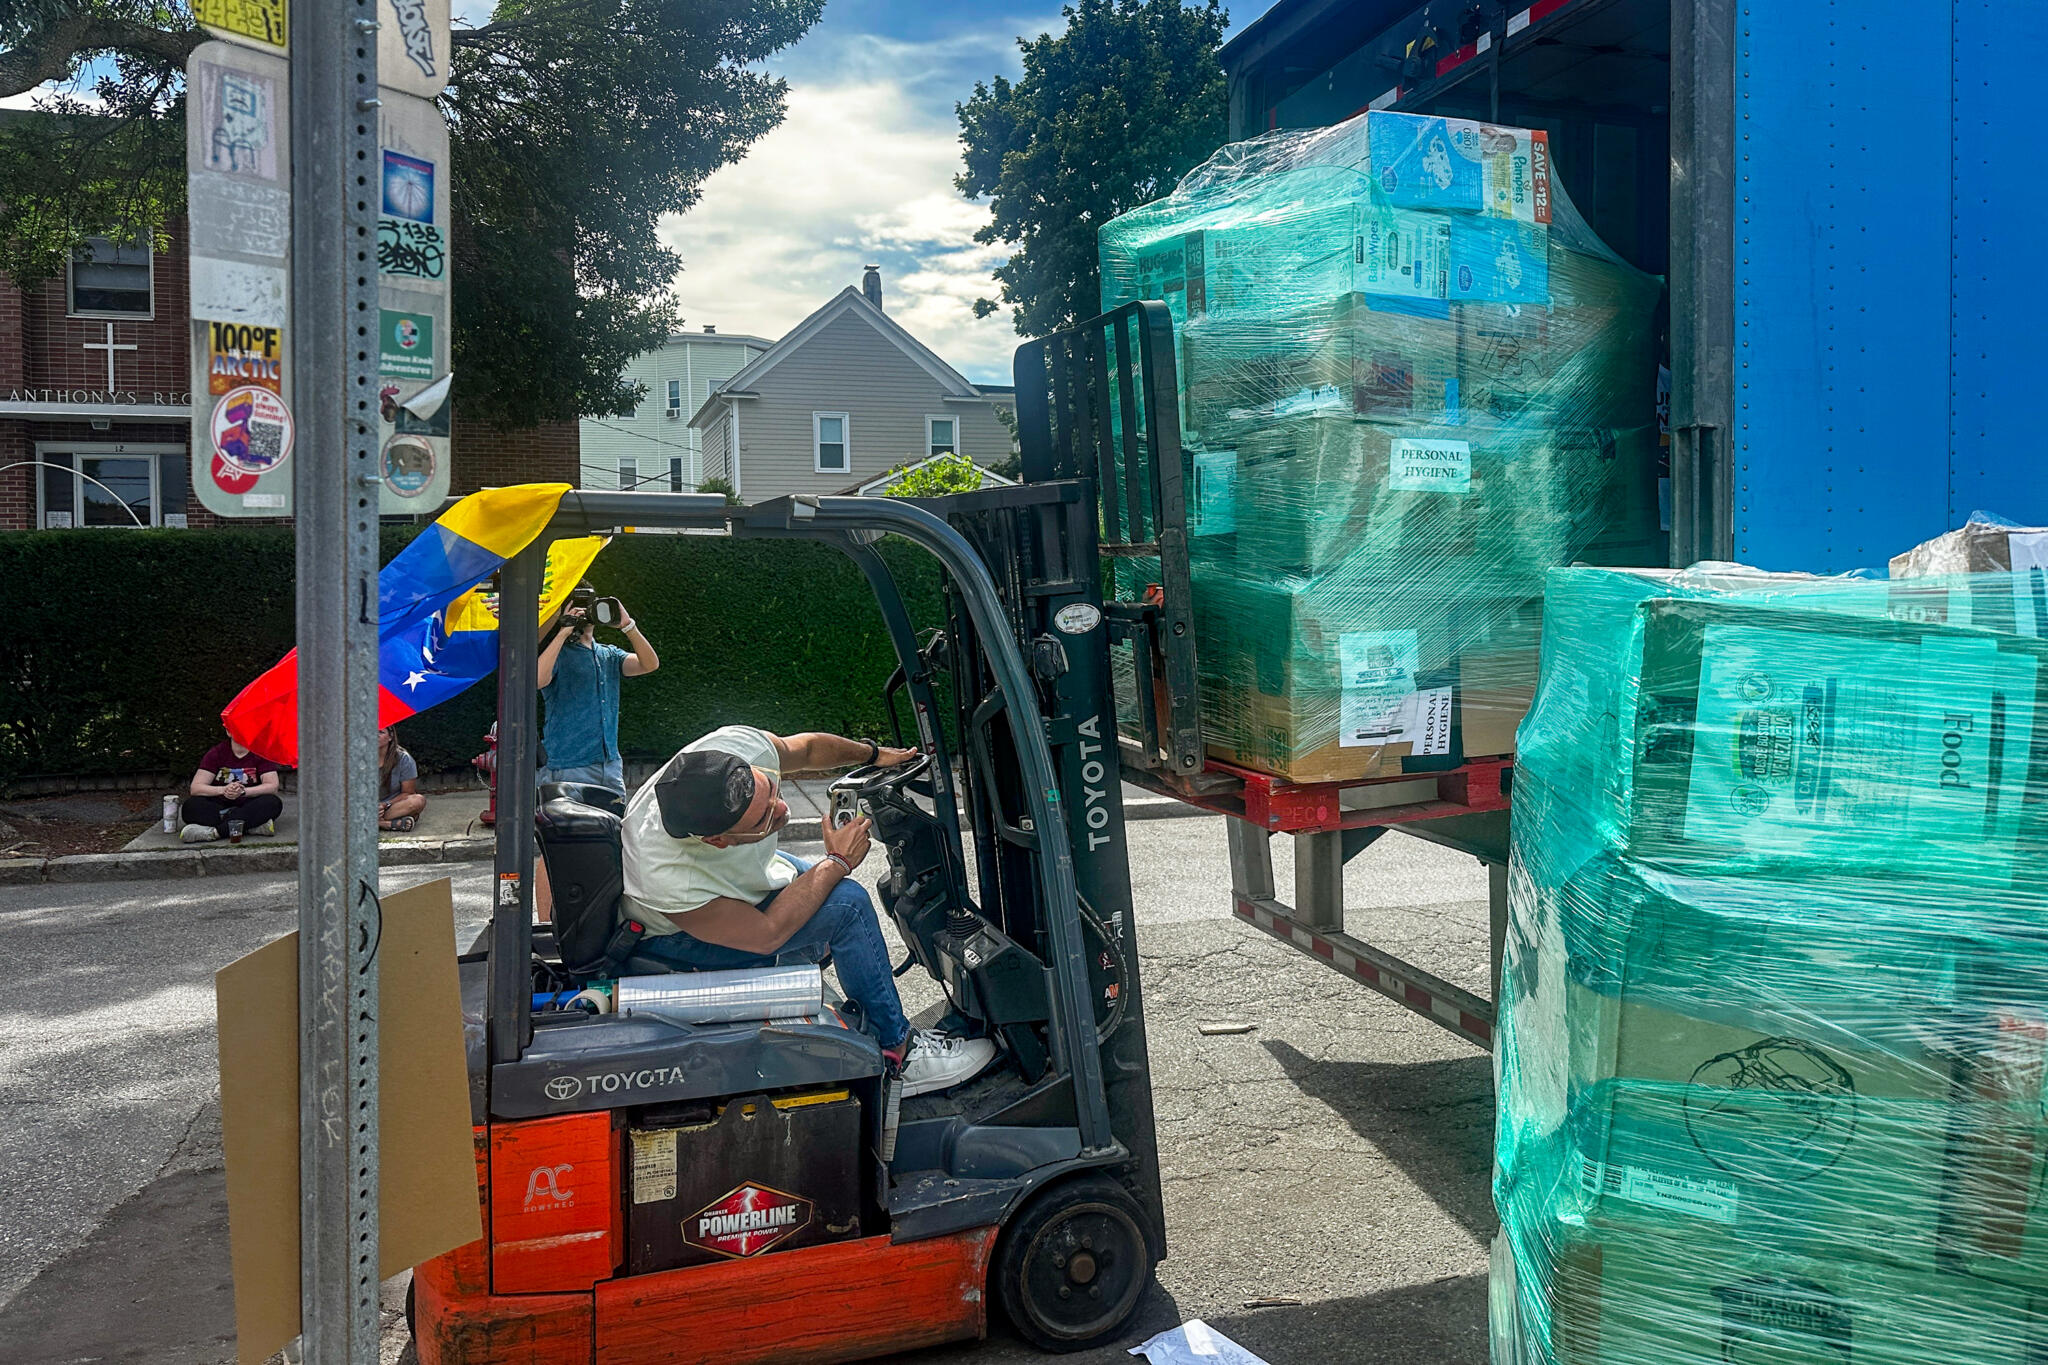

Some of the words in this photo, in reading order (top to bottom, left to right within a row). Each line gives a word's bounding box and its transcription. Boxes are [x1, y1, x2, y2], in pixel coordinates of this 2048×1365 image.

[1533, 141, 1547, 181] SAVE
[1513, 156, 1527, 204] Pampers
[1534, 184, 1548, 207] $12
[212, 355, 280, 380] ARCTIC
[9, 388, 137, 406] ANTHONY'S
[115, 445, 125, 453] 12
[1401, 448, 1463, 462] PERSONAL
[1405, 466, 1459, 478] HYGIENE
[1424, 690, 1438, 755] PERSONAL
[1438, 693, 1450, 750] HYGIENE
[1757, 717, 1771, 747] BOSTON
[1772, 714, 1793, 778] VENEZUELA
[1940, 711, 1974, 790] Food
[1754, 749, 1769, 775] DESDE
[1078, 715, 1111, 852] TOYOTA
[586, 1066, 685, 1094] TOYOTA
[524, 1163, 575, 1206] AC
[523, 1200, 575, 1213] POWERED
[699, 1204, 797, 1238] POWERLINE
[717, 1231, 753, 1243] PREMIUM
[752, 1227, 779, 1237] POWER
